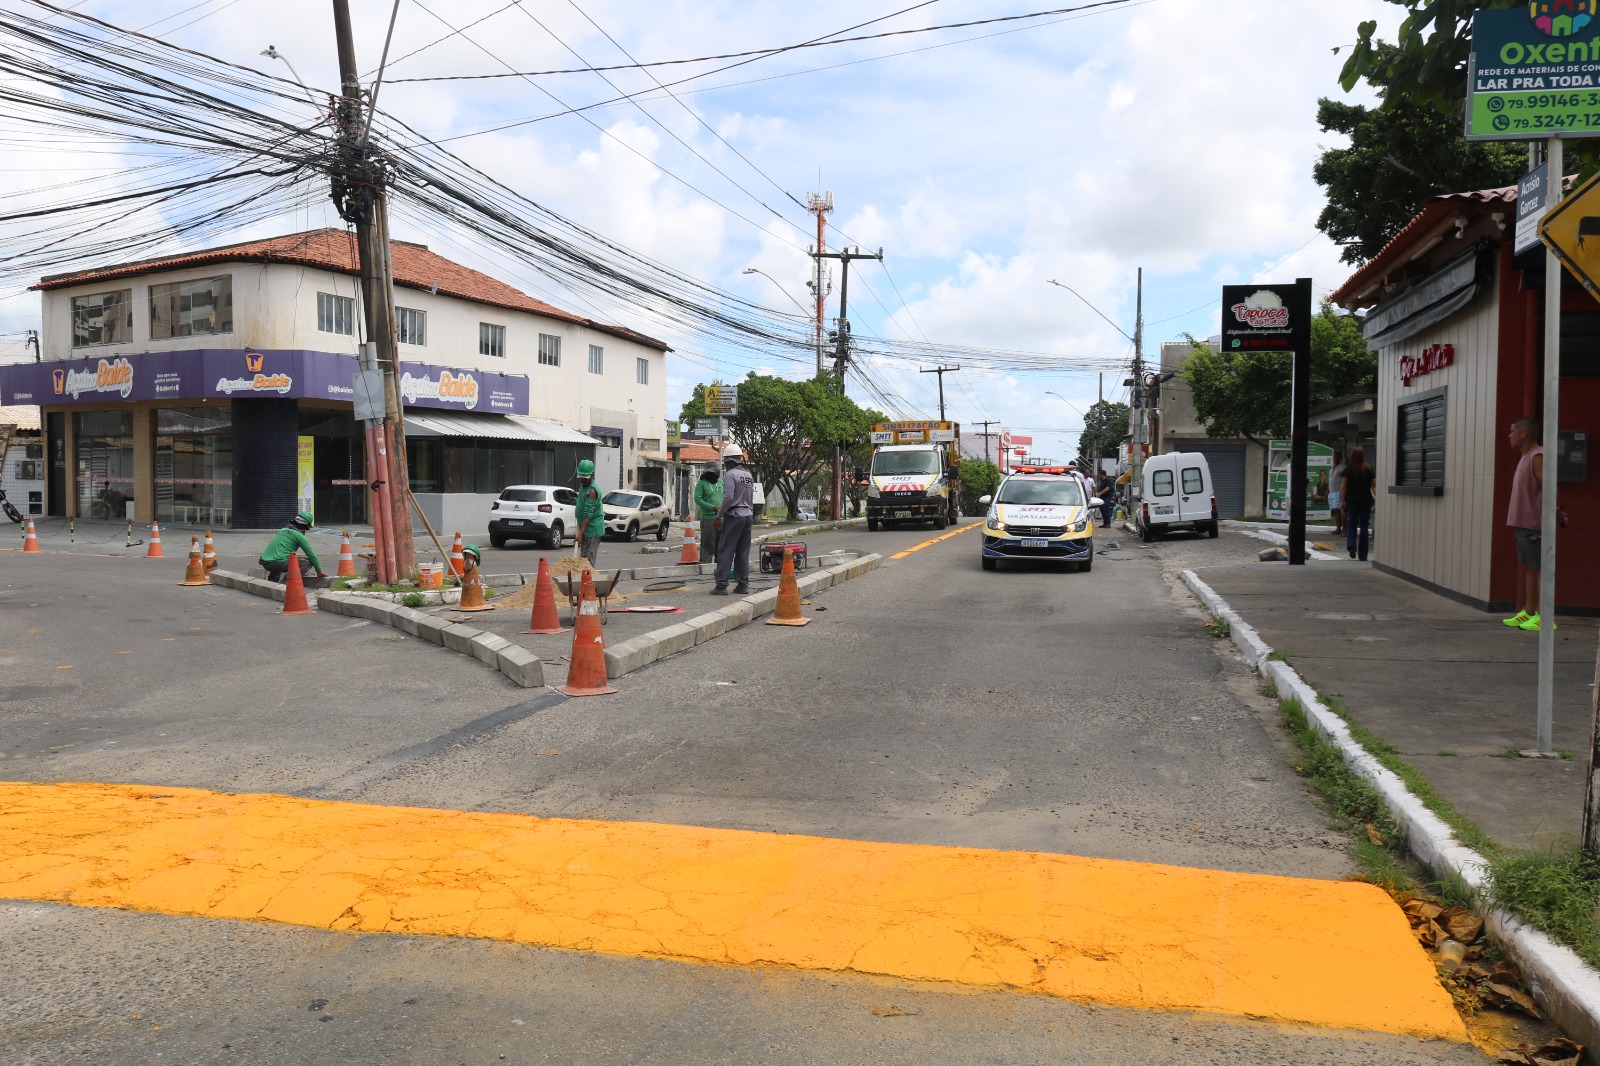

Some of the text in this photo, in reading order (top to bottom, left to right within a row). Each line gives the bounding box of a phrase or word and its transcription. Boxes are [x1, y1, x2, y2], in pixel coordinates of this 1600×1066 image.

[1517, 66, 1565, 74] MATERIAIS
[1477, 75, 1593, 90] LAR PRA TODA
[1521, 175, 1540, 197] Acrísio
[1520, 197, 1539, 216] Garcez
[1233, 305, 1287, 323] Tapioca
[97, 358, 132, 388] Balde
[253, 374, 290, 388] Balde
[439, 373, 477, 397] Balde
[875, 433, 892, 441] SMTT
